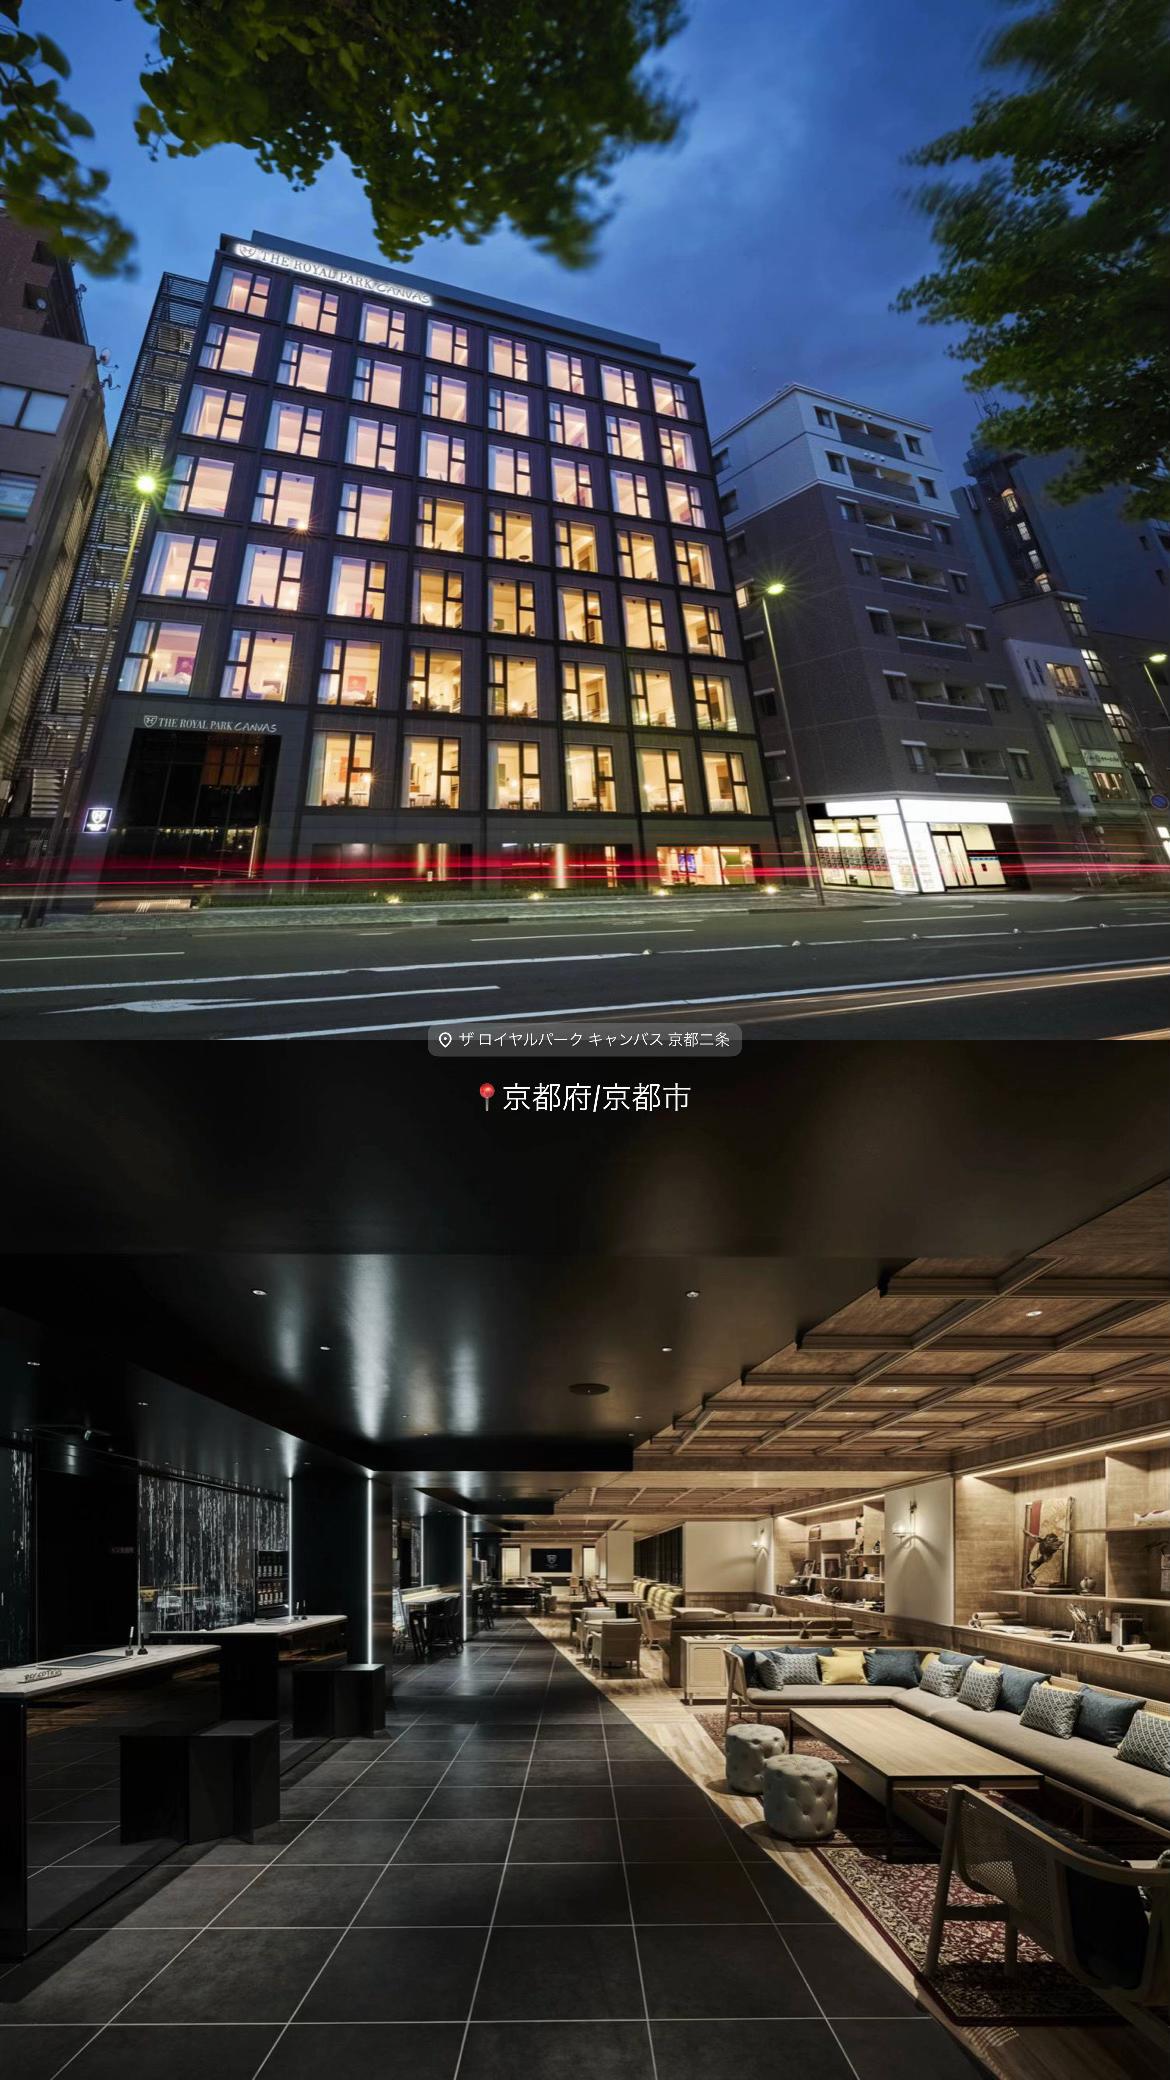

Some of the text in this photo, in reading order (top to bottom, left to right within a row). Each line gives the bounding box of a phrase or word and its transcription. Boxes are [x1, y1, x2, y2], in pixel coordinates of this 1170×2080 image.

[261, 252, 431, 304] THE ROYAL PARK CANVAS
[158, 718, 277, 733] THE ROYAL PARK CANVAS
